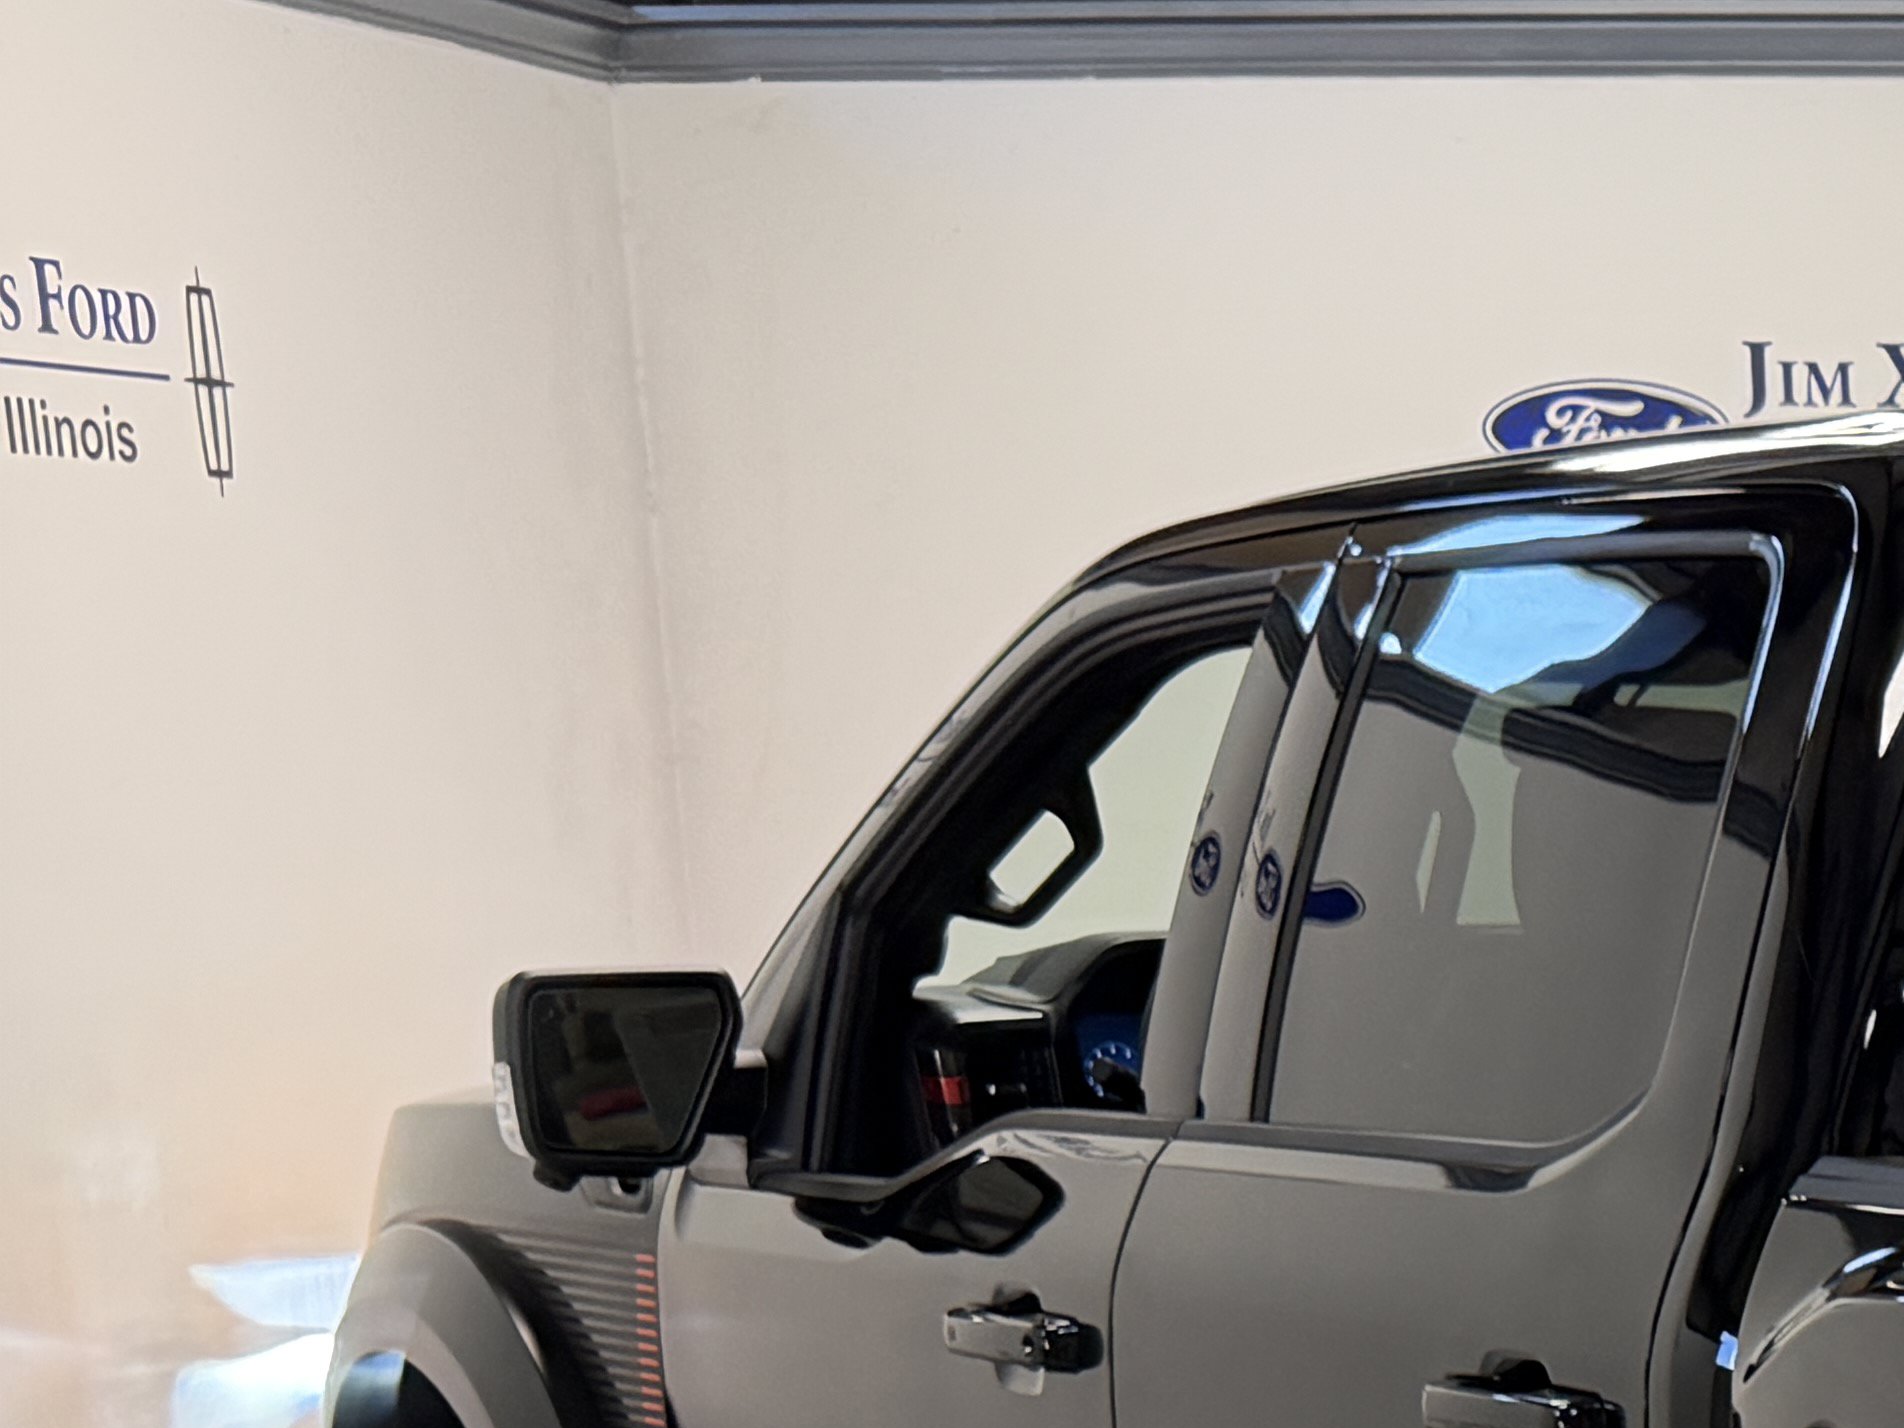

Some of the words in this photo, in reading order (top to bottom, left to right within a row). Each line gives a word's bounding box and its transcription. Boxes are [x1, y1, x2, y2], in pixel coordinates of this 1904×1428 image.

[29, 256, 156, 345] FORD
[1742, 341, 1855, 418] JIM
[4, 396, 138, 463] Illinois
